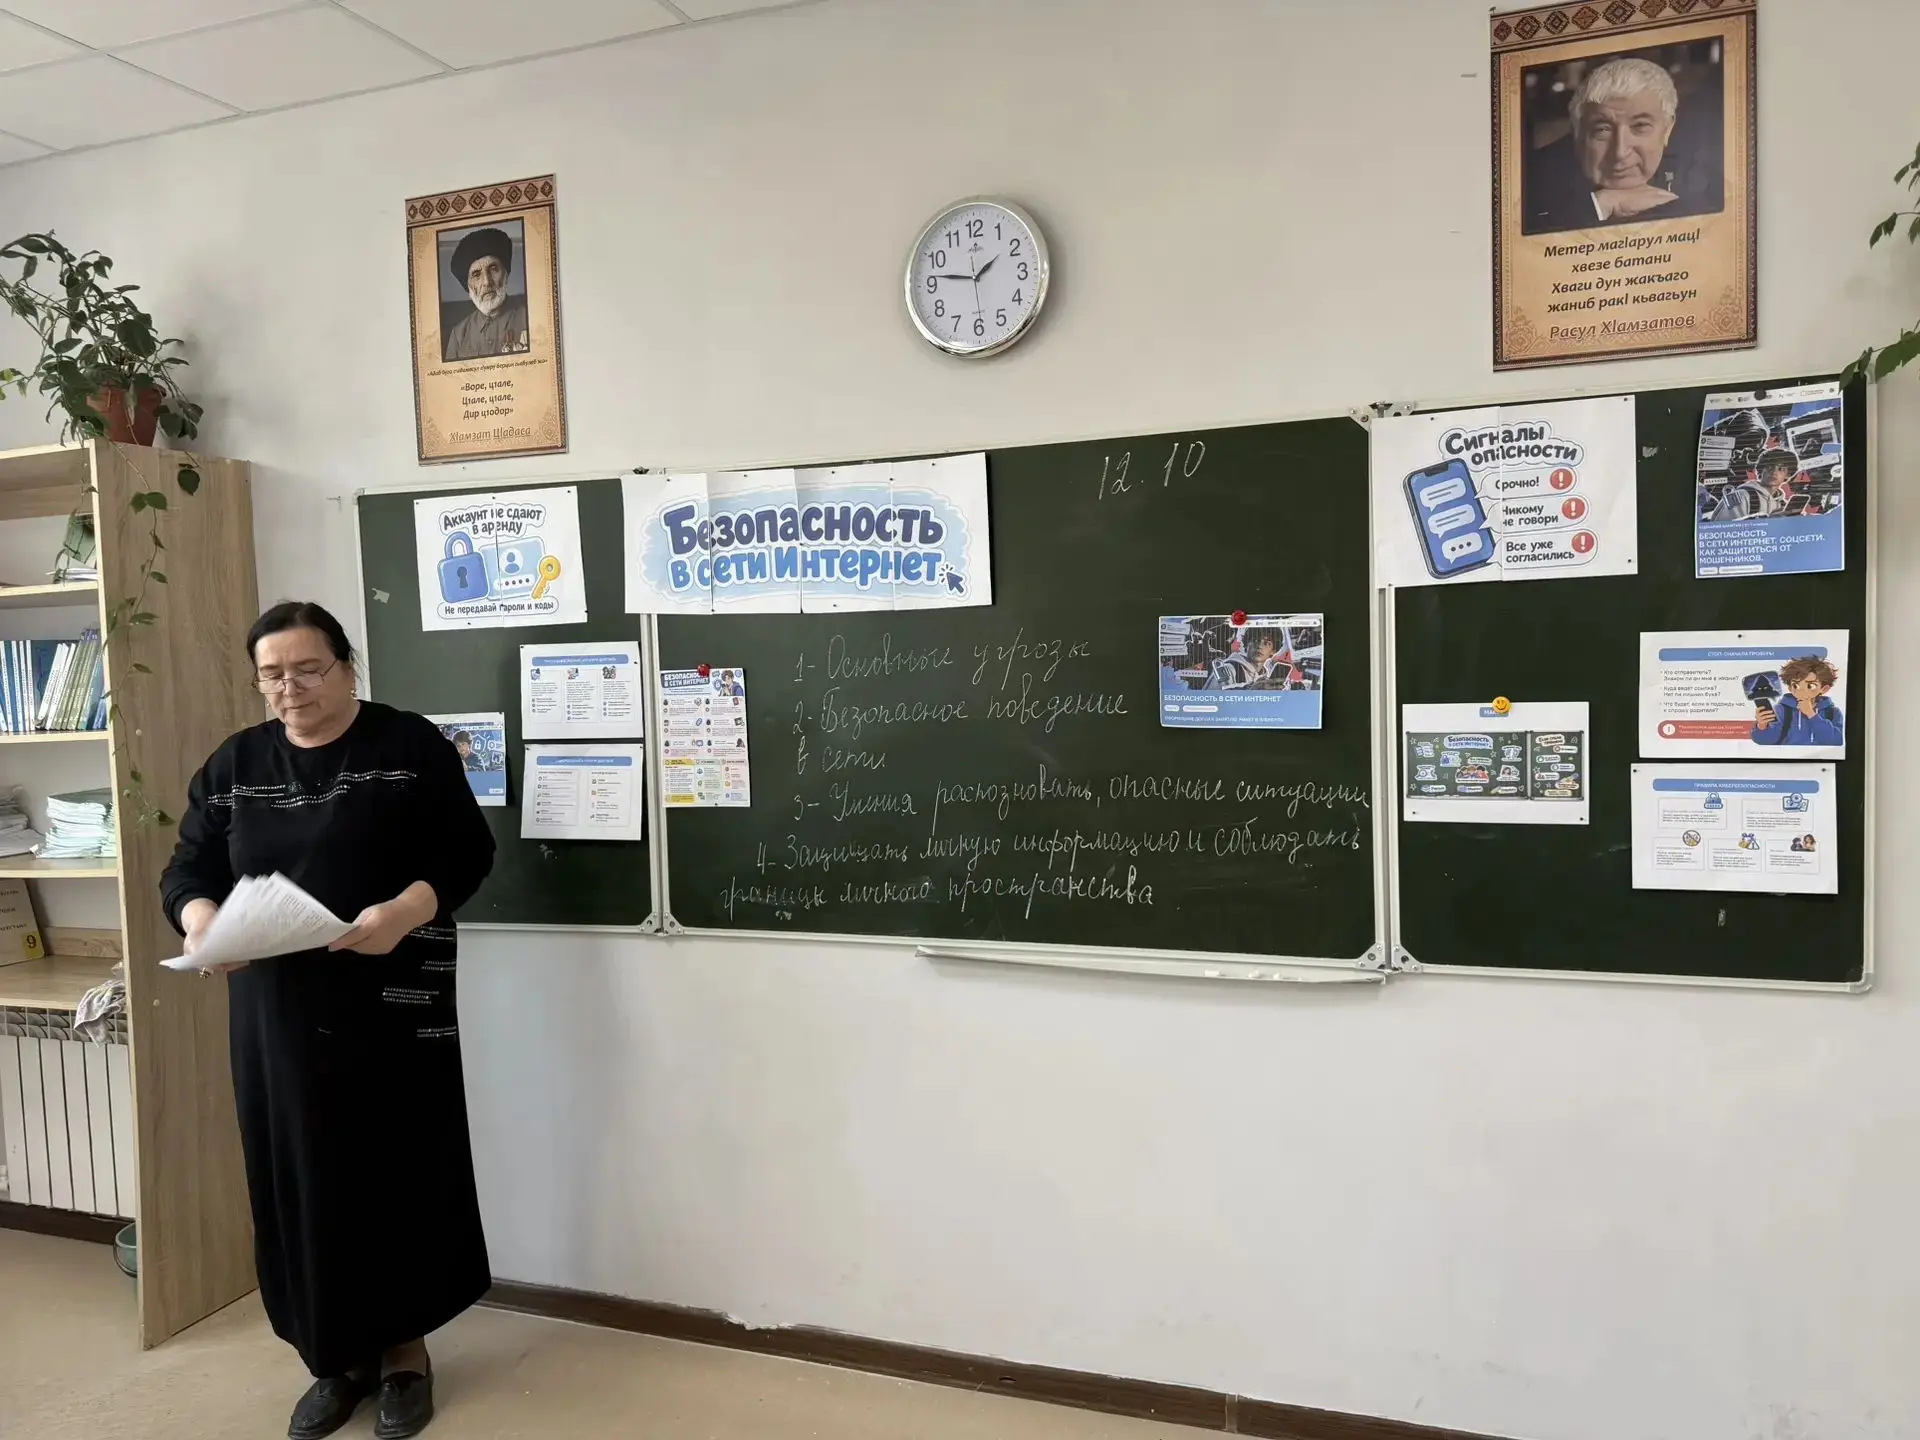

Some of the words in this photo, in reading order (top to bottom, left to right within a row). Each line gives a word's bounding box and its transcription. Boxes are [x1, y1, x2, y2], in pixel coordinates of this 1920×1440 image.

[945, 229, 960, 248] 11
[965, 219, 984, 239] 12
[994, 222, 1001, 241] 1
[1009, 238, 1021, 257] 2
[1544, 241, 1595, 258] Метер
[928, 250, 946, 269] 10
[1571, 260, 1611, 274] хвезе
[1614, 253, 1672, 269] батани
[1017, 262, 1028, 281] 3
[926, 275, 938, 294] 9
[1551, 280, 1592, 295] Хваги
[1595, 276, 1622, 292] дун
[1625, 269, 1689, 286] жакъаго
[1011, 288, 1023, 306] 4
[1547, 296, 1596, 313] жаниб
[1632, 287, 1697, 305] кьвагьун
[934, 299, 945, 318] 8
[995, 309, 1007, 327] 5
[951, 315, 962, 333] 7
[973, 318, 985, 337] 6
[1549, 325, 1596, 340] Расул
[460, 382, 487, 392] «Воре,
[463, 409, 480, 420] Дир
[1445, 425, 1545, 455] Сигналы
[1471, 444, 1577, 466] опасности
[443, 508, 489, 531] Аккаунт
[506, 506, 543, 521] сдают
[1518, 513, 1559, 528] говори
[472, 524, 479, 535] в
[663, 503, 944, 556] Безопасность
[1699, 530, 1767, 540] БЕЗОПАСНОСТЬ
[1505, 541, 1526, 553] Все
[1530, 541, 1554, 554] уже
[1699, 540, 1704, 548] В
[1706, 539, 1729, 547] СЕТИ
[1699, 548, 1716, 556] КАК
[1717, 546, 1778, 555] ЗАЩИТИТЬСЯ
[1779, 544, 1792, 552] ОТ
[1505, 550, 1575, 563] согласились
[1699, 554, 1764, 565] МОШЕННИКОВ.
[671, 560, 692, 589] в
[696, 551, 768, 587] сети
[774, 546, 943, 588] Интернет
[444, 605, 455, 615] Не
[457, 602, 497, 614] передавай
[527, 603, 532, 611] и
[534, 600, 554, 611] коды
[973, 628, 1092, 691] угрозы
[820, 687, 970, 740] Безопасное
[987, 673, 1129, 733] поведение
[1163, 694, 1218, 702] БЕЗОПАСНОСТЬ
[1225, 695, 1244, 703] СЕТИ
[1244, 695, 1282, 703] ИНТЕРНЕТ
[1109, 774, 1226, 801] опасные
[1013, 828, 1180, 872] информацию
[948, 865, 1153, 920] пространства
[26, 934, 37, 949] 9
